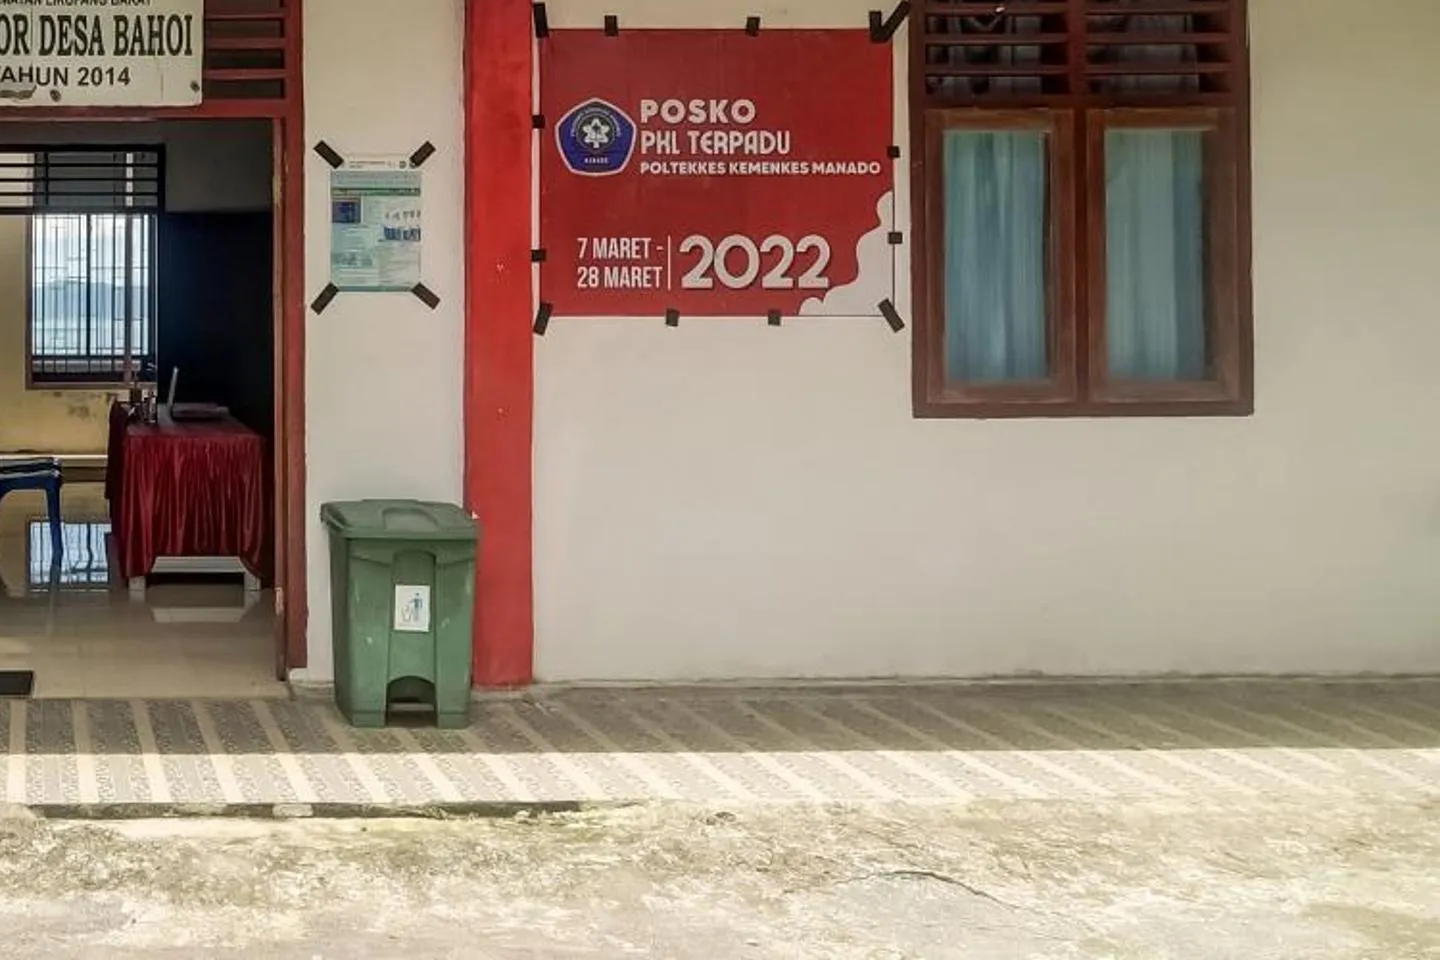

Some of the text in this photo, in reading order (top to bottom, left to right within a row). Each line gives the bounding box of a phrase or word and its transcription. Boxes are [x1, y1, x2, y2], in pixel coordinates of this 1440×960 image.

[38, 14, 105, 56] DESA
[112, 14, 193, 56] BAHOI
[77, 66, 131, 87] 2014
[640, 98, 756, 124] POSKO
[686, 130, 790, 155] TERPADU
[640, 161, 881, 175] POLTEKKES KEMENKES MANADO
[577, 238, 587, 259] 7
[593, 238, 652, 259] MARET
[679, 234, 831, 289] 2022
[577, 266, 663, 288] 28 MARET
